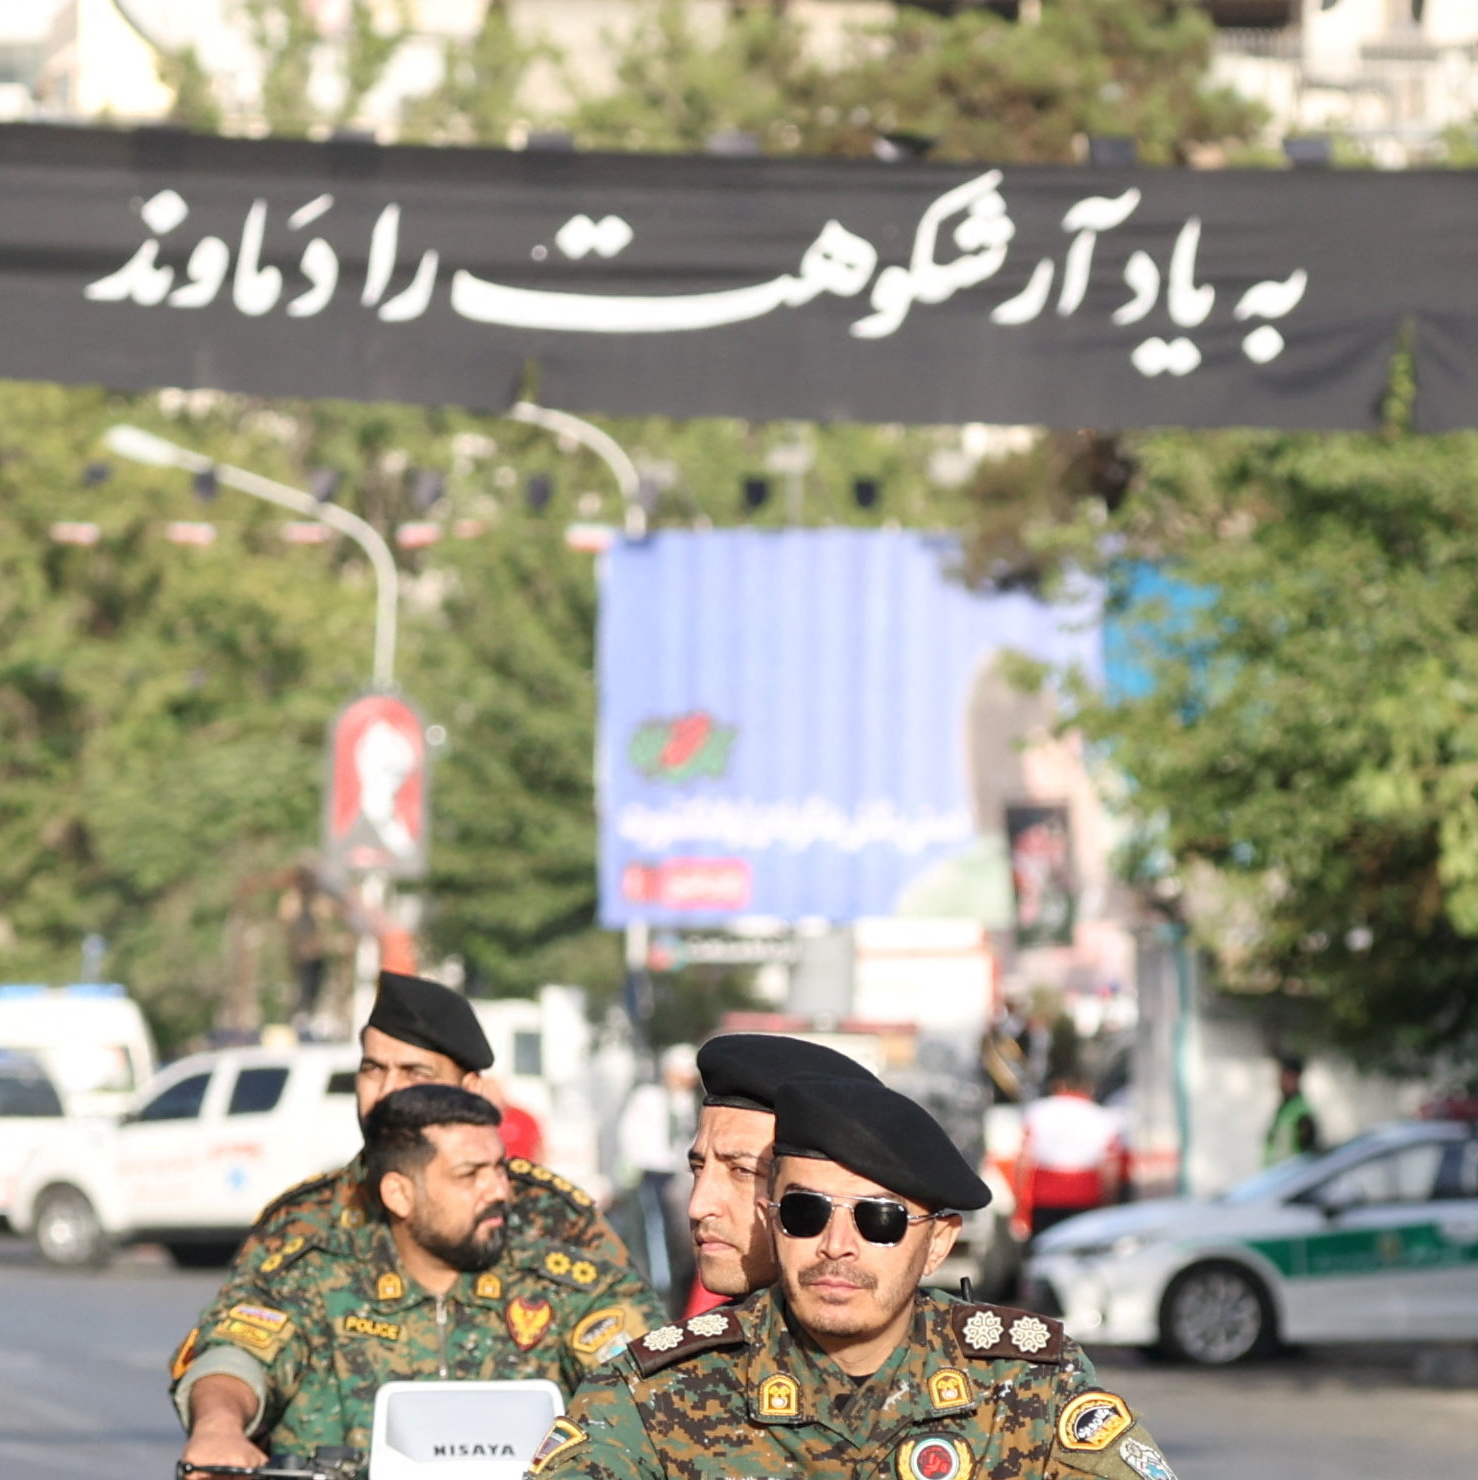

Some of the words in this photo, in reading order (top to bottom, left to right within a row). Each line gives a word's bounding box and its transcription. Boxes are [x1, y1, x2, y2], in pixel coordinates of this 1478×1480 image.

[362, 203, 438, 322] را
[451, 169, 1016, 339] شکوهت
[1234, 267, 1307, 364] به
[346, 1315, 400, 1340] POLICE
